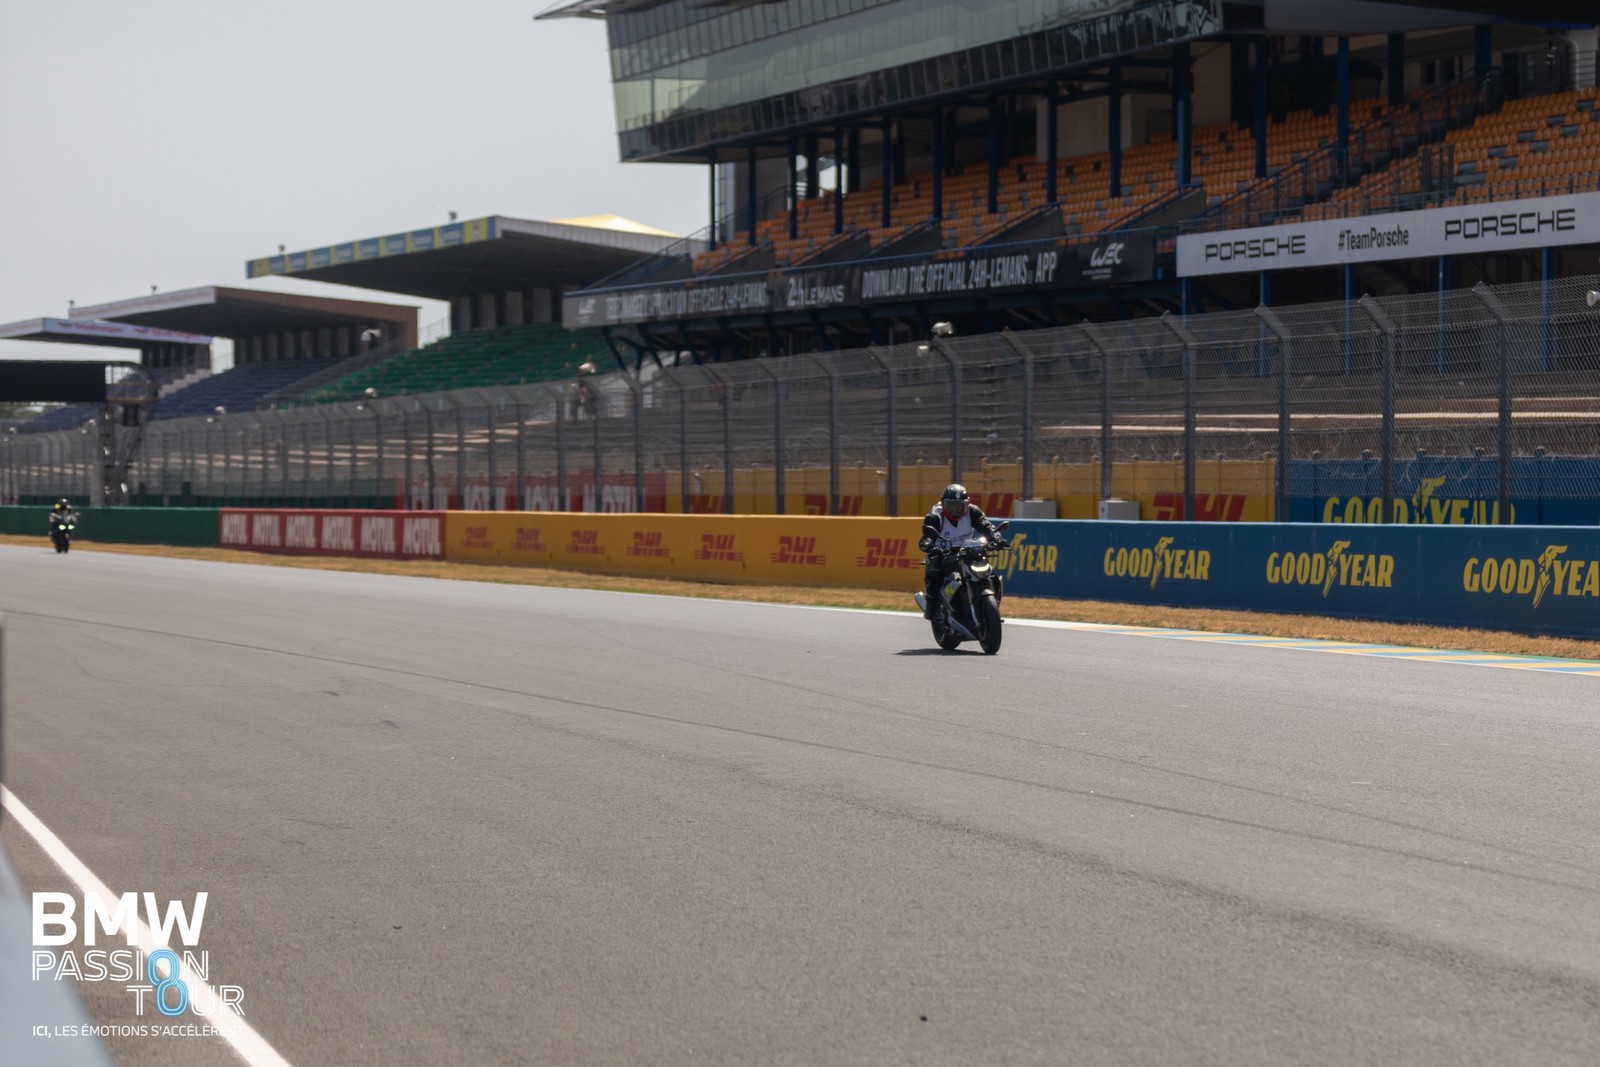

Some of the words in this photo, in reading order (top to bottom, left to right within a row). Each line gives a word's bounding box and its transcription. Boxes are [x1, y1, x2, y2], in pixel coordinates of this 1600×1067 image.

[1338, 225, 1409, 251] #TeamPorsche
[1445, 208, 1576, 241] PORSCHE
[1090, 242, 1124, 267] WEC
[1205, 235, 1306, 262] PORSCHE
[862, 267, 908, 299] DOWNLOAD
[908, 265, 925, 294] THE
[926, 261, 966, 292] OFFICIAL
[968, 254, 1029, 289] 24H-LEMANS
[1035, 251, 1058, 283] APP
[321, 516, 354, 550] MOTUL
[360, 517, 396, 553] MOTUL
[402, 518, 441, 555] MOTUL
[631, 531, 664, 557] DHL
[700, 534, 737, 561] DHL
[777, 536, 818, 565] DHL
[865, 538, 911, 568] DHL
[1104, 545, 1210, 582] GOODYEAR
[1266, 550, 1394, 589] GOODYEAR
[1463, 555, 1600, 598] GOODYEA
